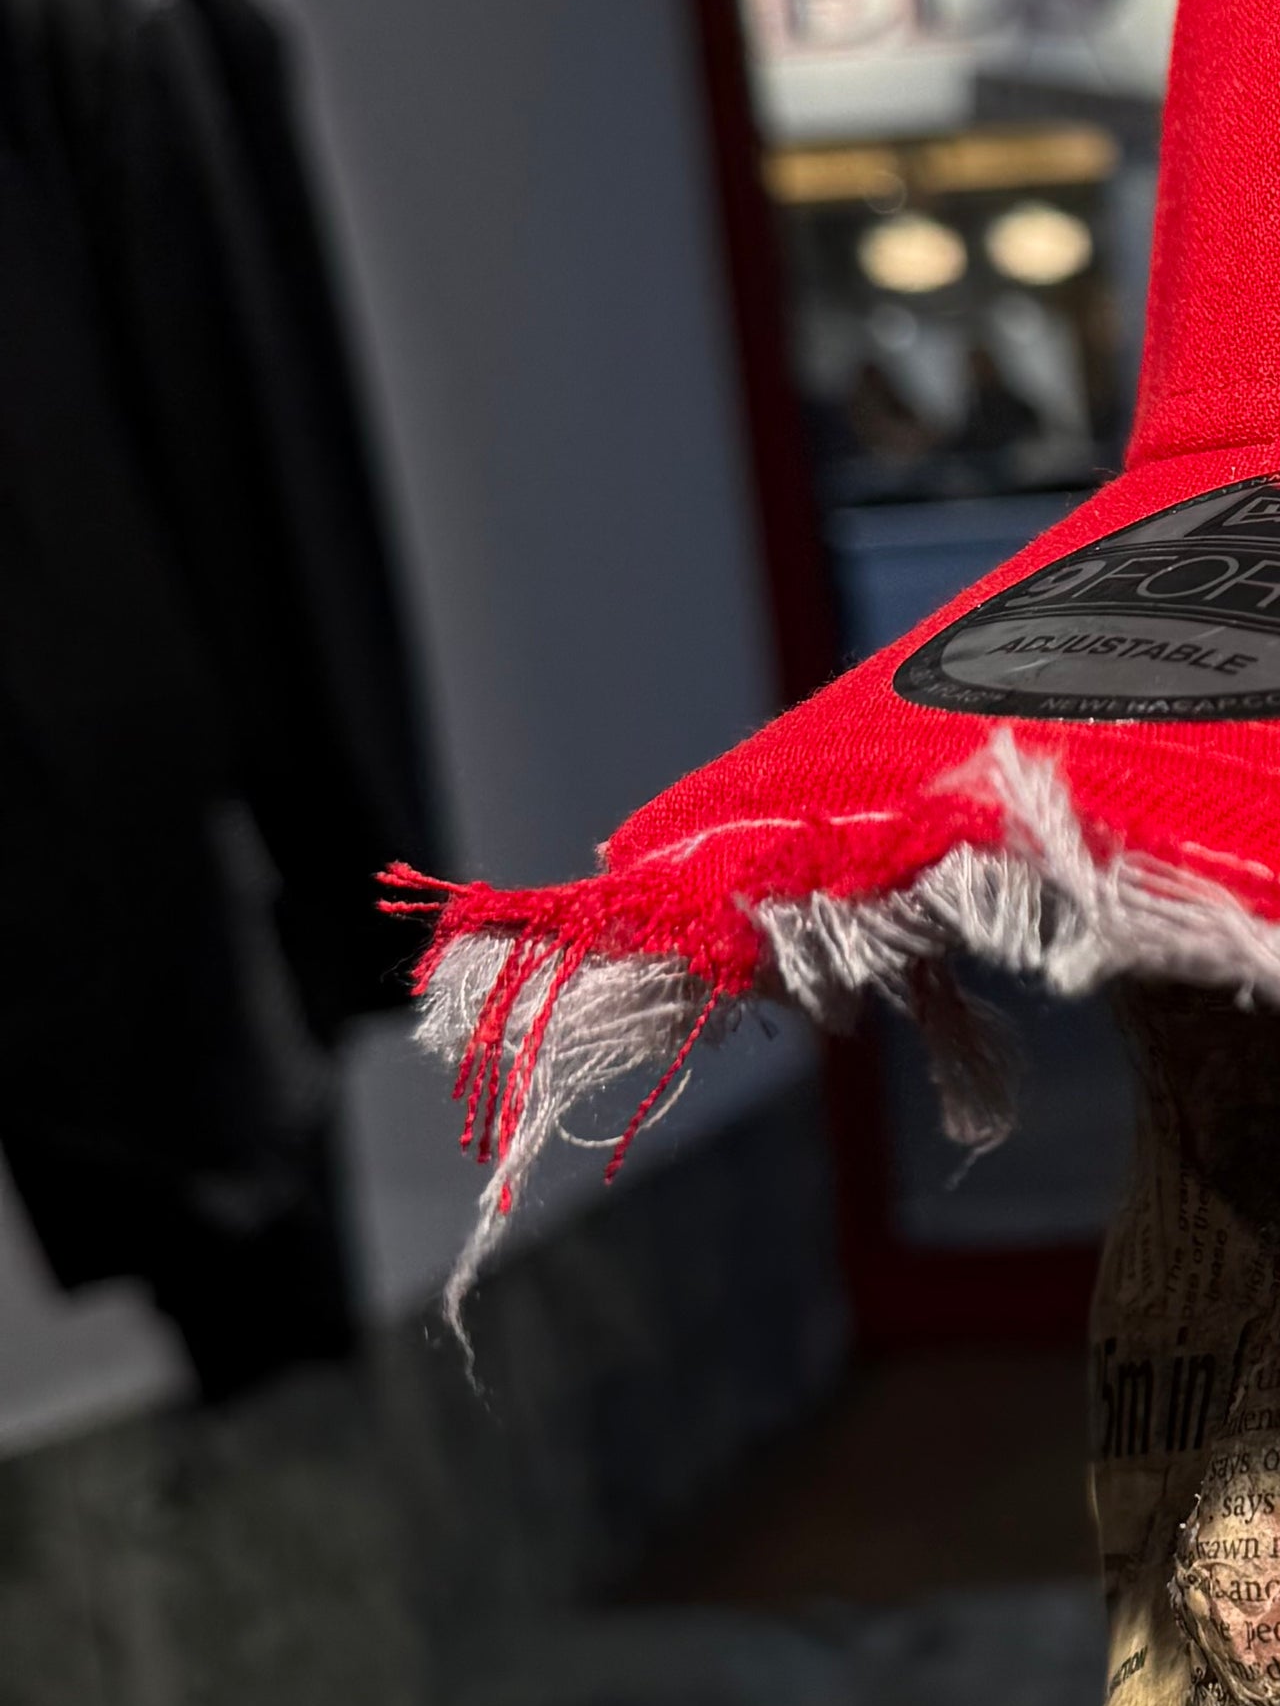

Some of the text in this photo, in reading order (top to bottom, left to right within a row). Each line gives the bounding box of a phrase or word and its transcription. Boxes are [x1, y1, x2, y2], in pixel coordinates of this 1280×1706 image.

[987, 634, 1259, 676] ADJUSTABLE
[1208, 1450, 1250, 1482] says
[1220, 1492, 1276, 1525] says
